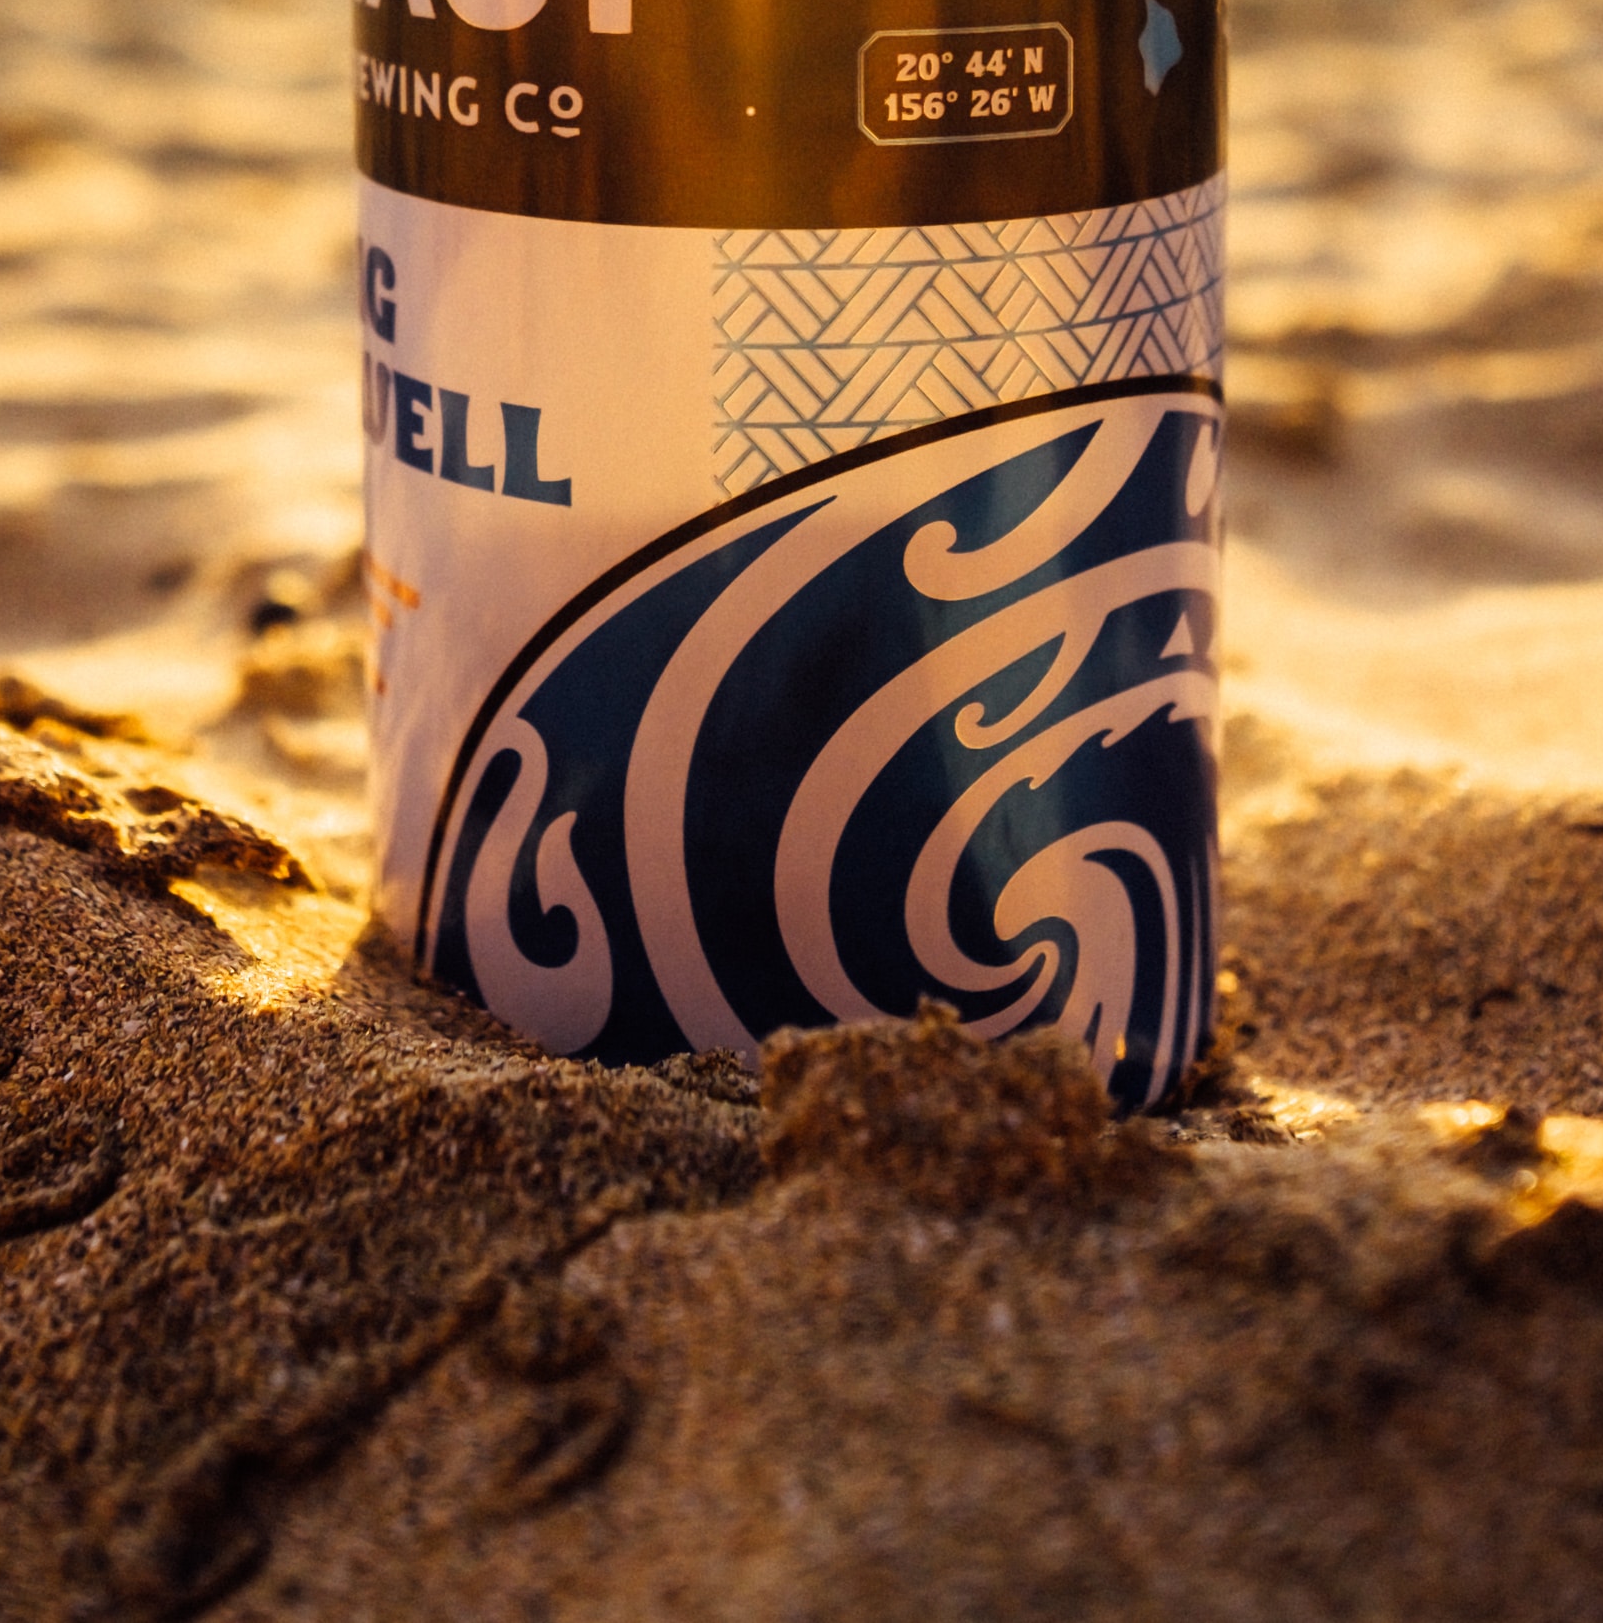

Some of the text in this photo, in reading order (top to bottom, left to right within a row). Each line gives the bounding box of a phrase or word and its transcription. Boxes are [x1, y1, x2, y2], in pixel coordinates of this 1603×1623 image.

[896, 51, 954, 82] 20°
[1023, 46, 1044, 75] N
[884, 90, 959, 122] 156°
[1028, 84, 1057, 114] W
[358, 235, 396, 345] G
